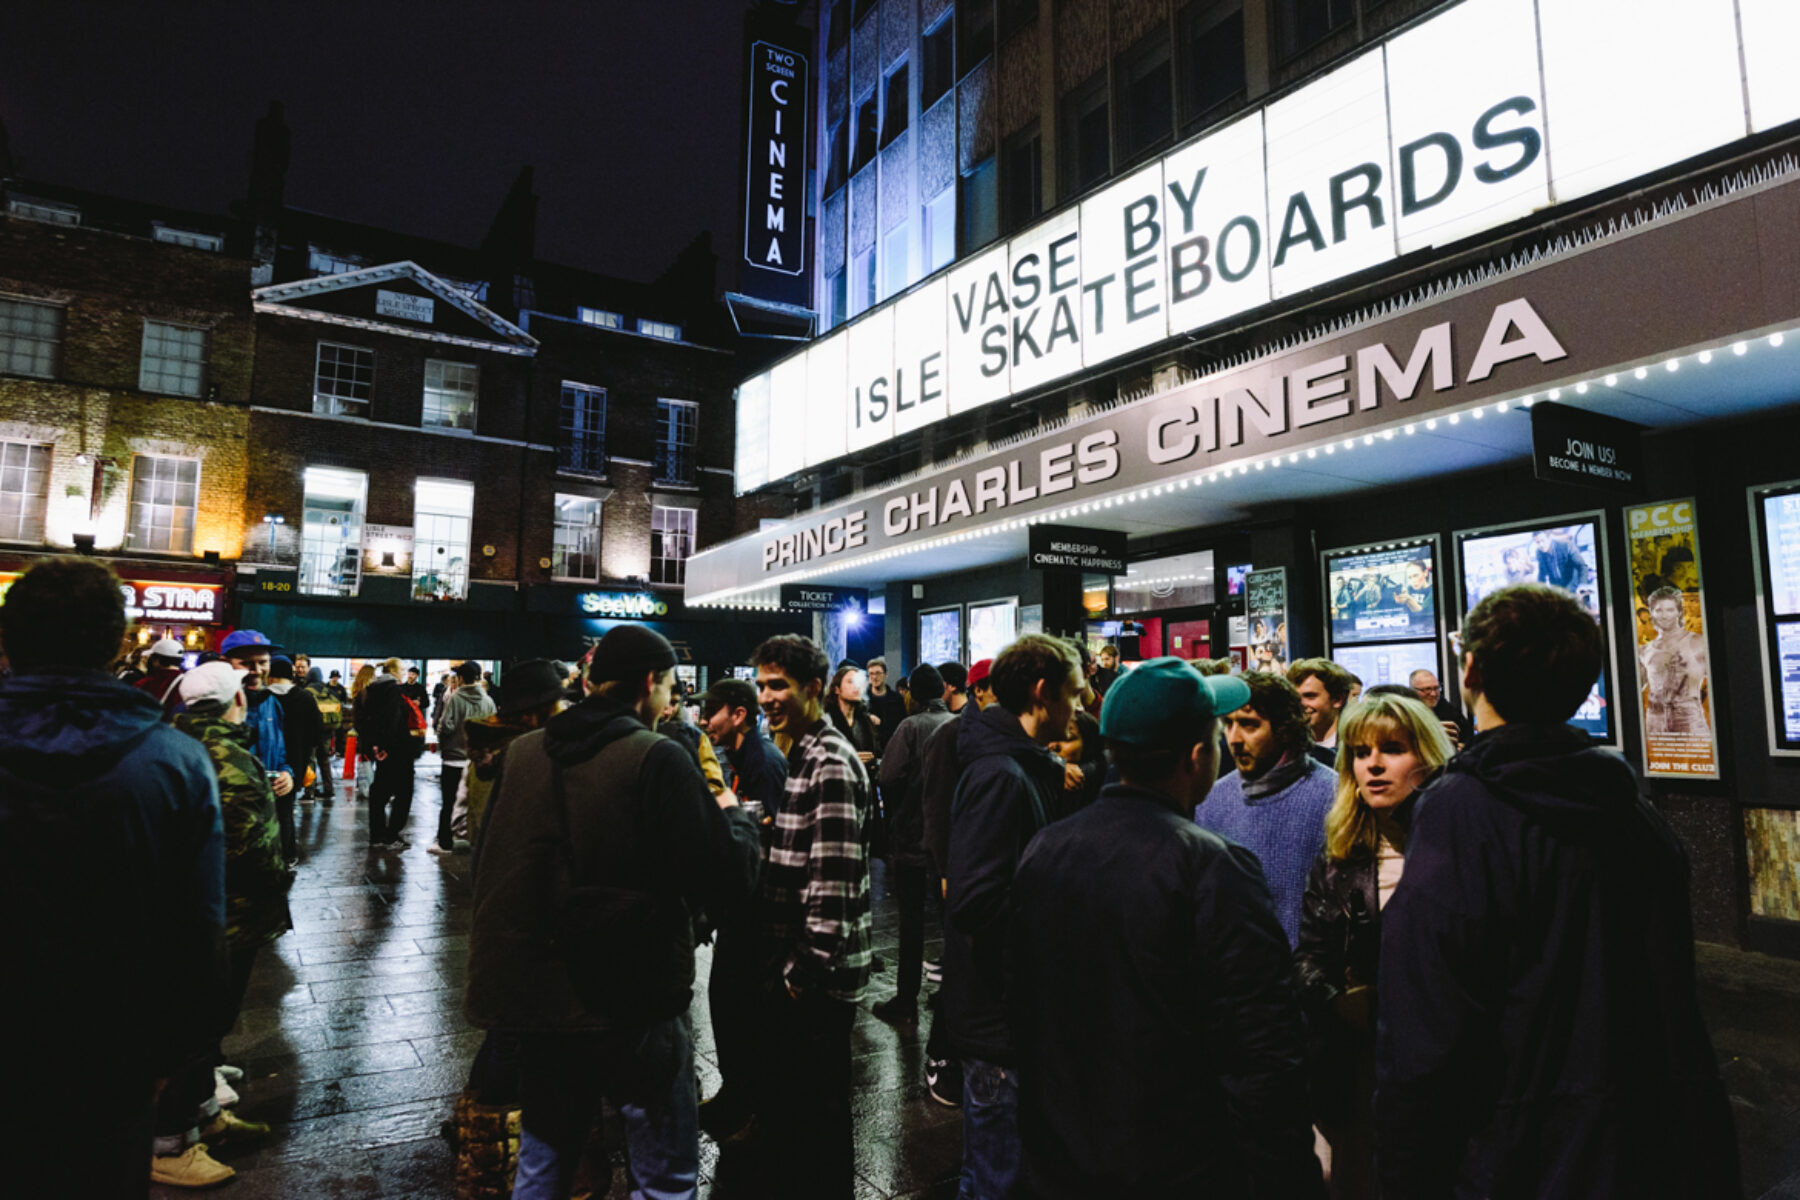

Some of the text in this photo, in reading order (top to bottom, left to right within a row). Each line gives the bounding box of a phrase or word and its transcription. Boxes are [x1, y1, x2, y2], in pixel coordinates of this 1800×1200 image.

[767, 49, 795, 67] TWO
[766, 62, 795, 79] SCREEN
[766, 79, 789, 265] CINEMA
[952, 166, 1209, 335] VASE BY
[855, 95, 1543, 429] ISLE SKATEBOARDS
[763, 297, 1569, 571] PRINCE CHARLES CINEMA
[1565, 438, 1616, 465] JOIN US!
[1549, 455, 1632, 481] BECOME A MEMBER NOW
[1631, 503, 1691, 530] PCC
[1631, 524, 1694, 539] MEMBERSHIP
[1050, 541, 1099, 554] MEMBERSHIP
[1034, 553, 1122, 569] CINEMATIC HAPPINESS
[261, 581, 291, 592] 18-20
[1249, 586, 1282, 601] ZACH
[143, 585, 215, 609] STAR
[582, 593, 668, 615] SeeWoo
[788, 600, 825, 608] COLLECTION
[800, 590, 834, 602] TICKET
[1649, 761, 1715, 772] JOIN THE CLUB
